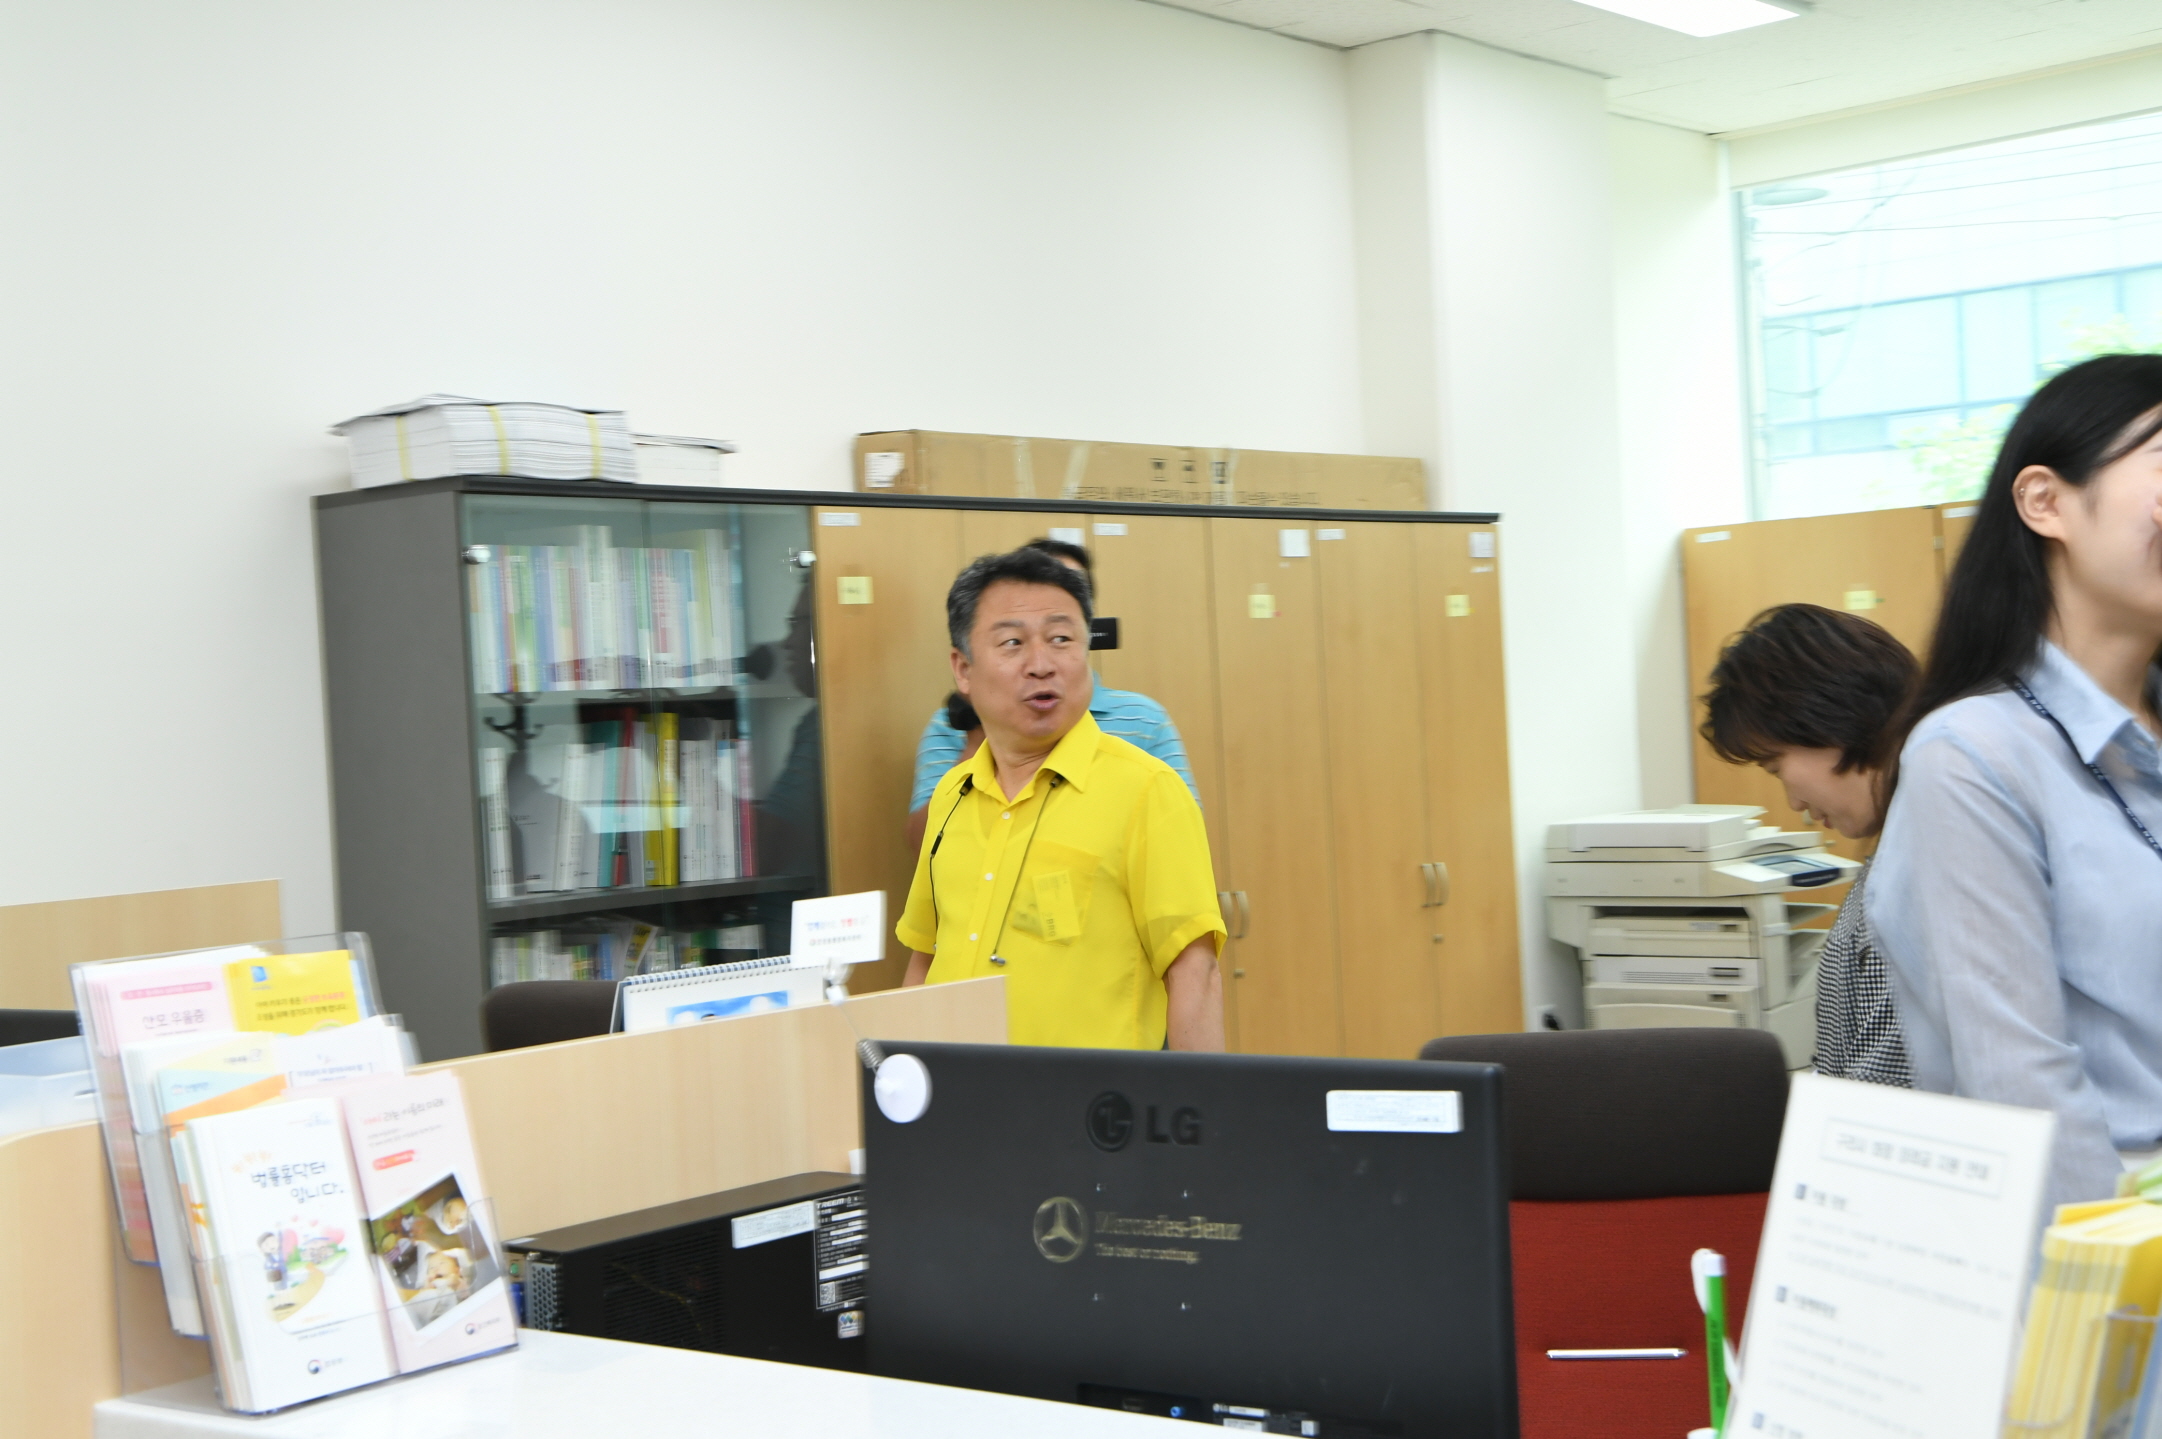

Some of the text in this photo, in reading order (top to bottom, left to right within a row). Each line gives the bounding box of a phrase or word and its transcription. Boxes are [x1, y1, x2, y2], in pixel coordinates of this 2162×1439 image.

[142, 1009, 206, 1030] 산모 우울증
[1147, 1105, 1202, 1146] LG
[290, 1182, 345, 1204] 입니다.
[1095, 1211, 1243, 1241] Mercedes-Benz
[1095, 1243, 1114, 1257] The
[1115, 1245, 1138, 1258] best
[1139, 1248, 1151, 1259] or
